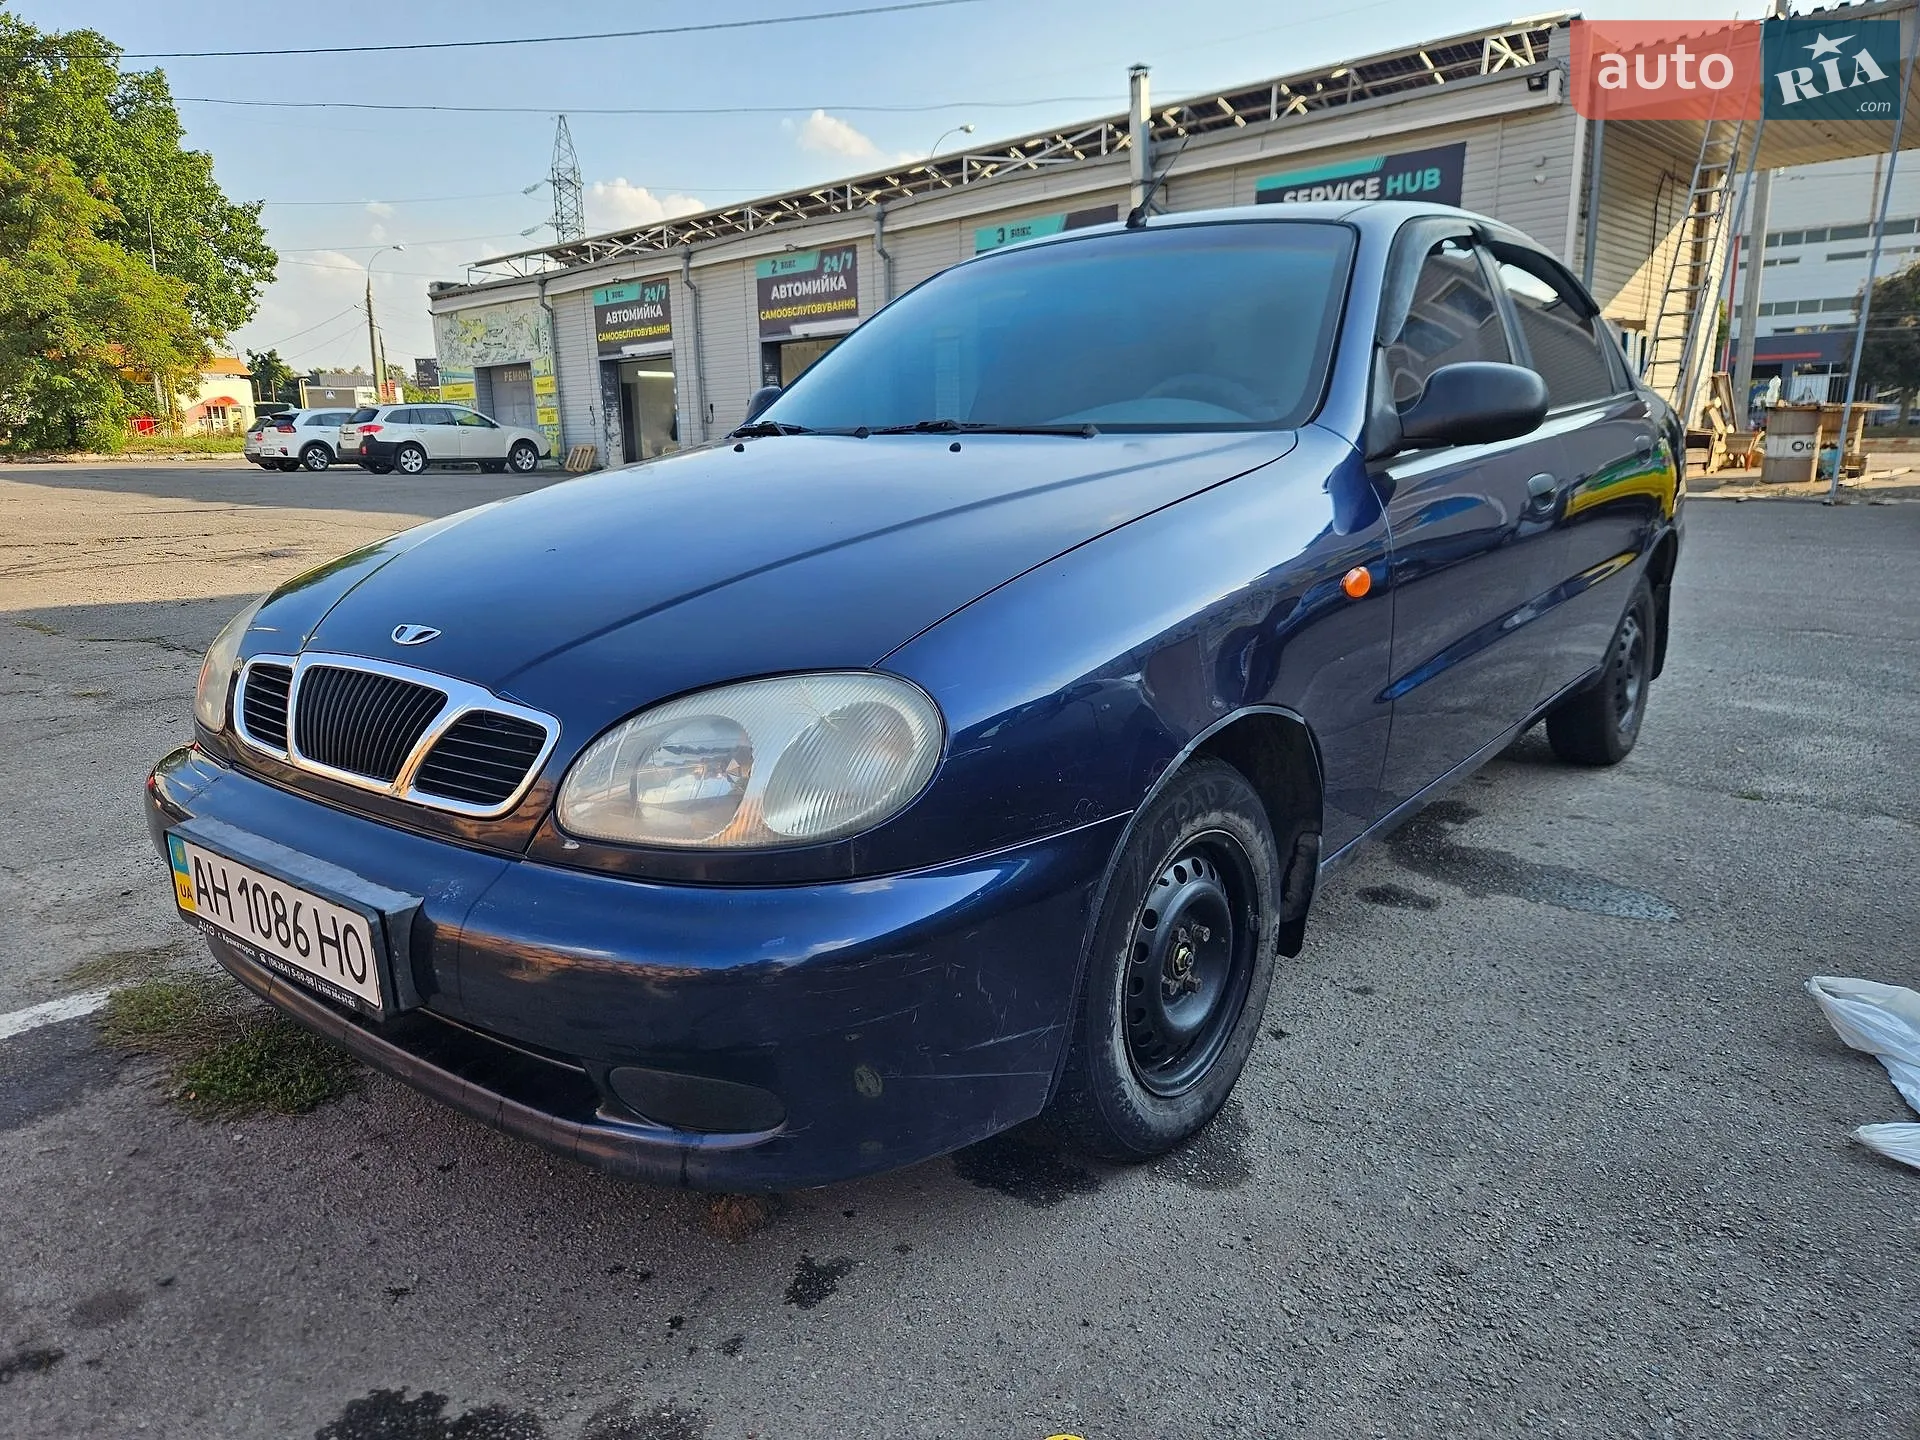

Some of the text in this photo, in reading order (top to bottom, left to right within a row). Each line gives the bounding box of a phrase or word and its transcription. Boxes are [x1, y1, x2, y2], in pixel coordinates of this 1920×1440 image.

[1385, 167, 1442, 198] HUB
[770, 259, 778, 275] 2
[823, 250, 853, 274] 24/7
[643, 284, 667, 303] 24/7
[770, 275, 848, 301] АВТОМИЙКА
[605, 303, 664, 325] АВТОМИЙКА
[760, 297, 857, 321] САМООБСЛУГОВУВАННЯ
[597, 324, 671, 342] САМООБСЛУГОВУВАННЯ
[179, 883, 194, 902] UA
[193, 855, 367, 985] AH 1086 HO
